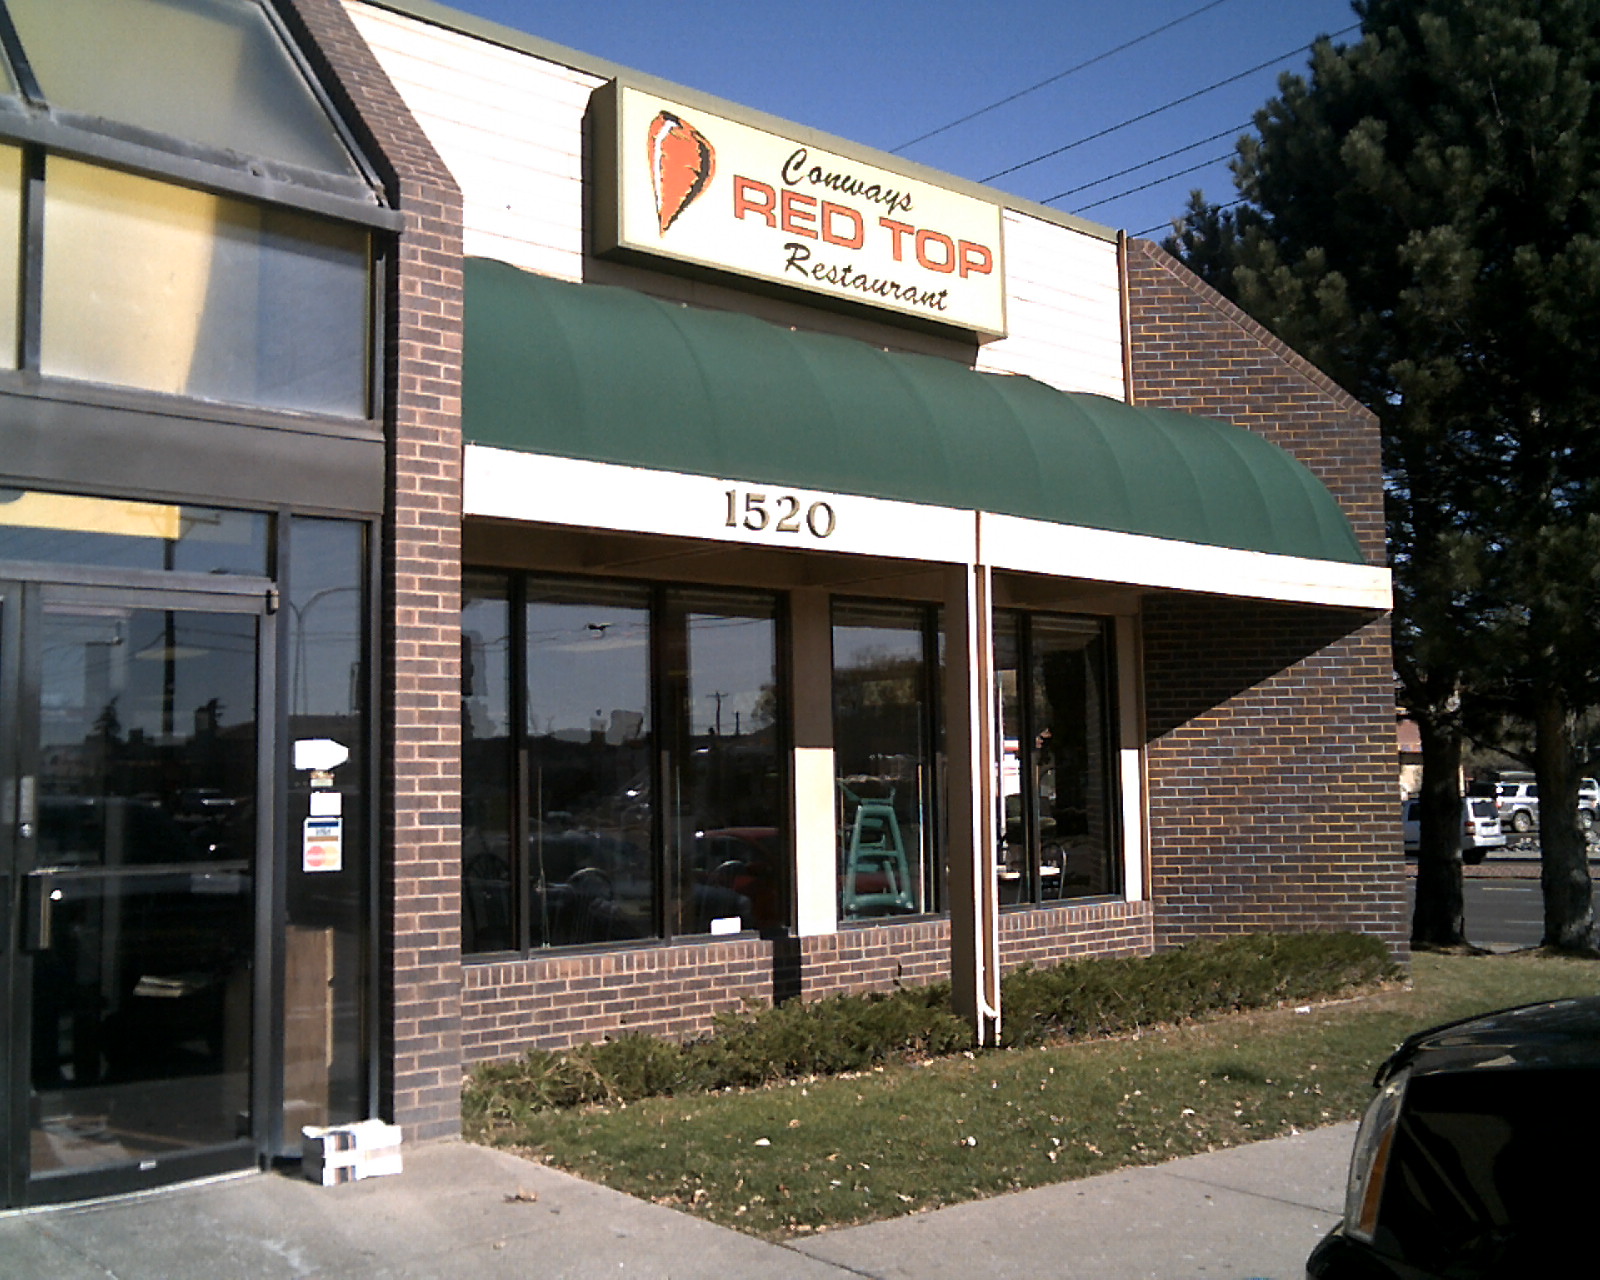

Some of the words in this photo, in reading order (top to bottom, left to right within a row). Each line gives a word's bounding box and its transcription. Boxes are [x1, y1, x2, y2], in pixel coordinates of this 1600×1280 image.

[782, 148, 913, 215] Conways
[733, 175, 864, 250] RED
[879, 217, 993, 279] TOP
[784, 242, 947, 311] Restaurant
[725, 489, 836, 538] 1520
